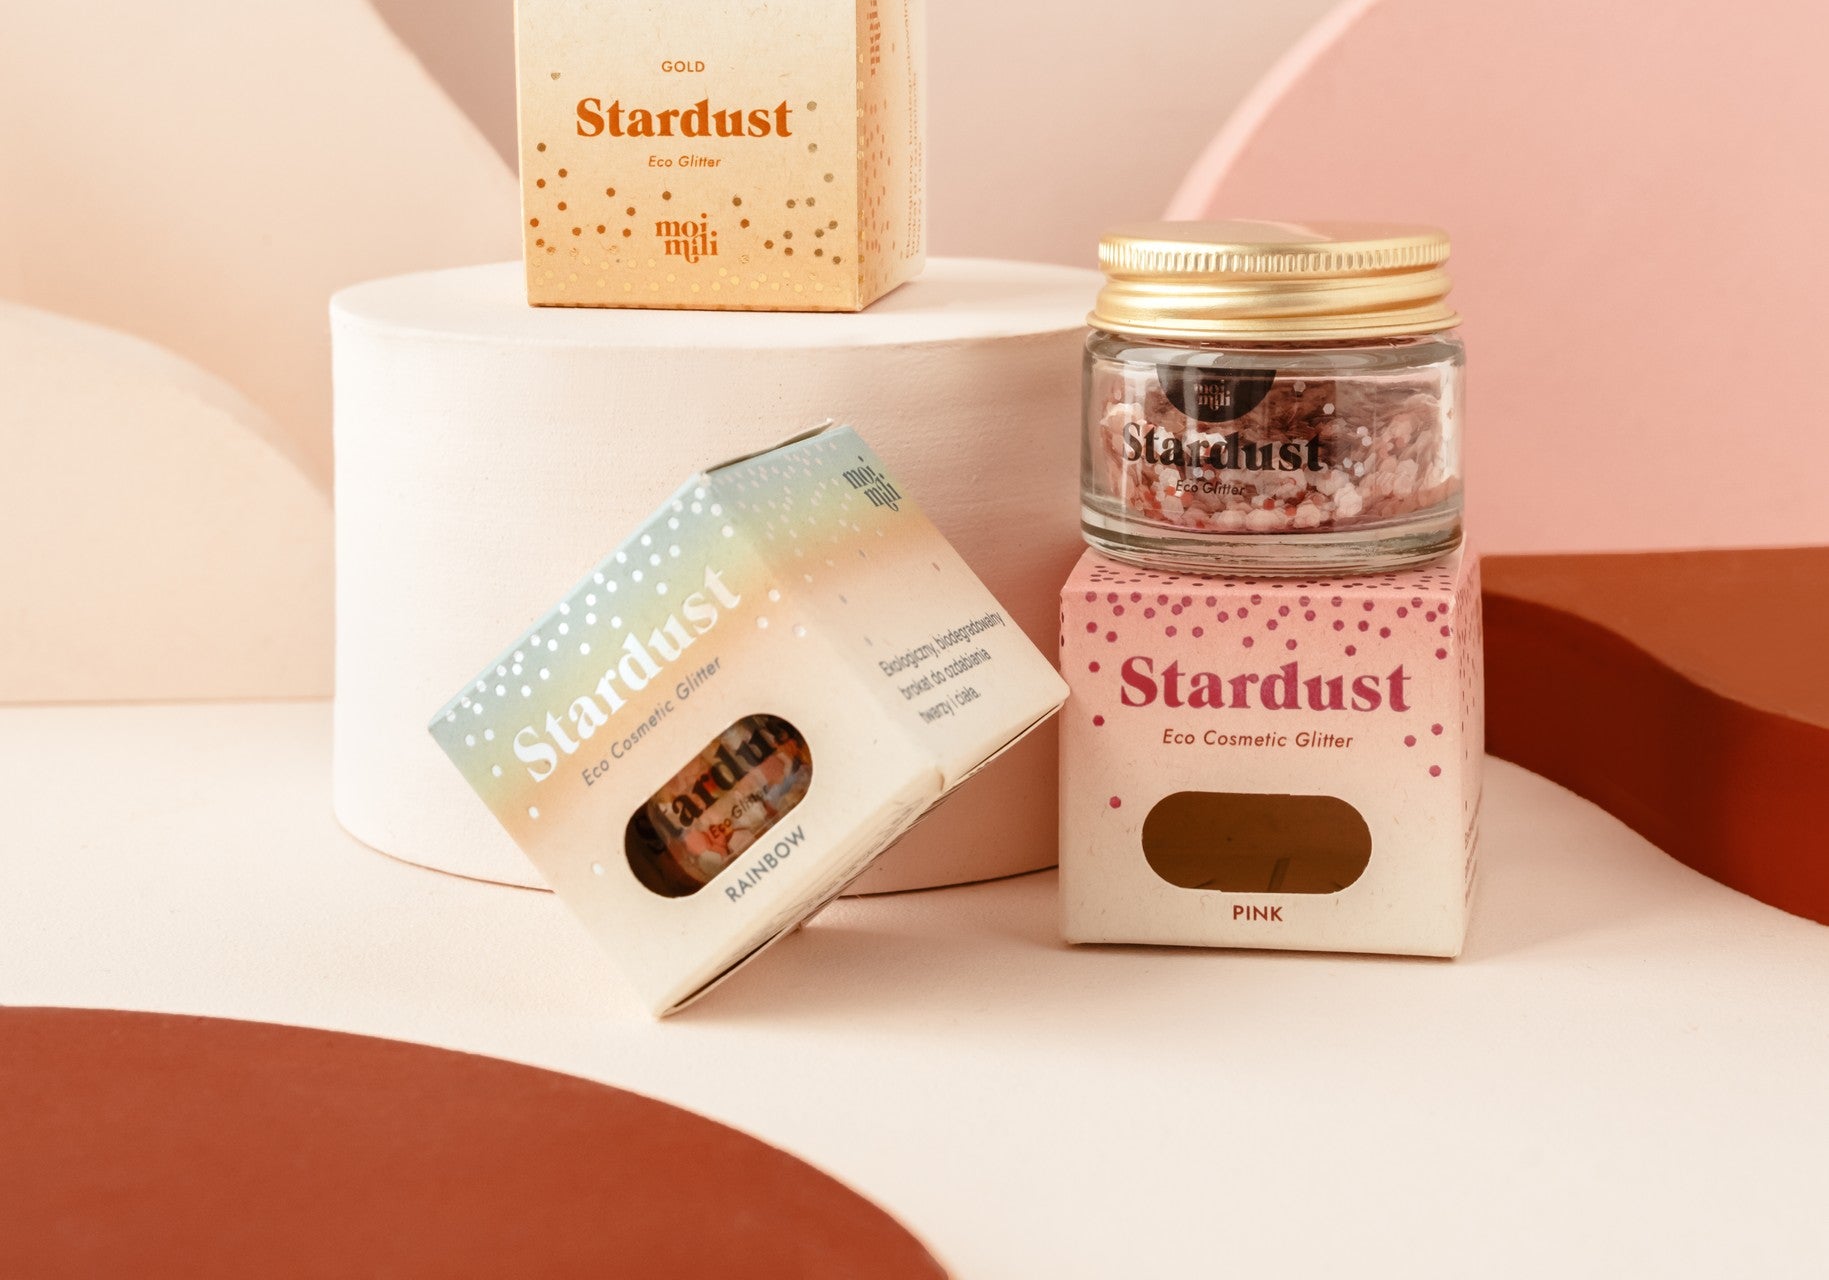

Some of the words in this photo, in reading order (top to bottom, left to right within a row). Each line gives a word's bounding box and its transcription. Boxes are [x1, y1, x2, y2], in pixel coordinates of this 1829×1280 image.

[661, 60, 706, 74] GOLD
[576, 97, 793, 138] Stardust
[648, 155, 673, 168] Eco
[678, 155, 722, 169] Glitter
[655, 213, 708, 238] moi
[1122, 422, 1324, 472] Stardust
[842, 455, 877, 489] moi
[1175, 480, 1198, 493] Eco
[1202, 481, 1245, 496] Glitter
[512, 565, 742, 783] Stardust
[930, 669, 947, 685] do
[1120, 656, 1412, 713] Stardust
[581, 761, 610, 787] Eco
[610, 699, 675, 760] Cosmetic
[675, 656, 722, 701] Glitter
[1162, 729, 1196, 746] Eco
[1203, 730, 1288, 748] Cosmetic
[1295, 731, 1354, 749] Glitter
[725, 825, 806, 902] RAINBOW
[1232, 904, 1284, 922] PINK
